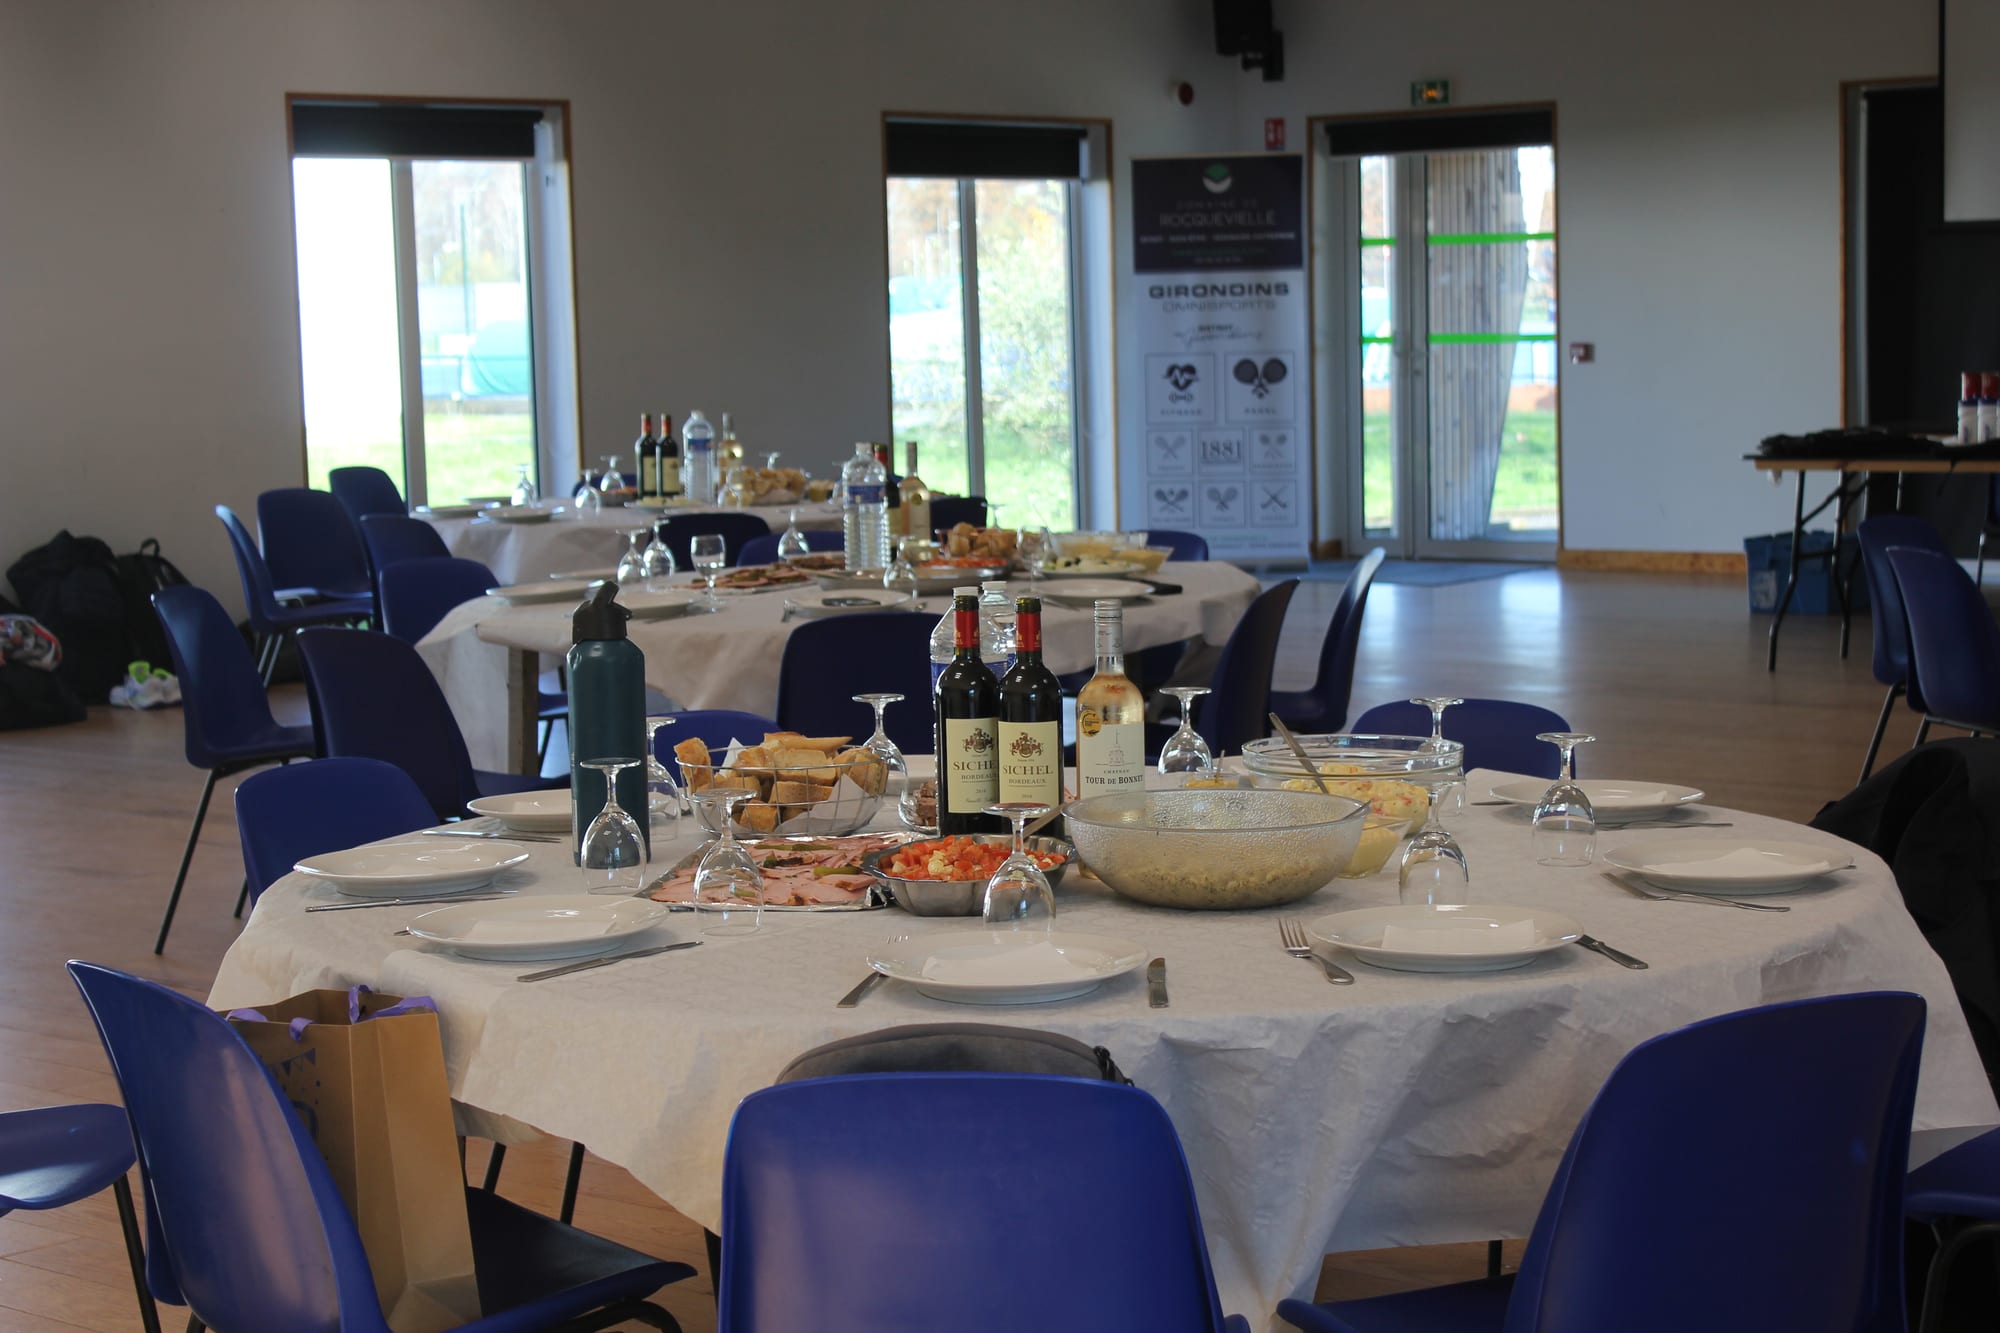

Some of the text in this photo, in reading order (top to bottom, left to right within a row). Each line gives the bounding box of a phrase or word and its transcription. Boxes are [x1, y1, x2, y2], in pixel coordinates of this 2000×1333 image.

[1149, 281, 1289, 299] GIRONDINS
[1162, 300, 1276, 313] OMNISPORTS
[1202, 440, 1242, 460] 1881
[953, 760, 997, 771] SICHE
[1002, 765, 1053, 775] SICHEL
[1085, 776, 1105, 785] TOUR
[1118, 774, 1143, 784] BONNET
